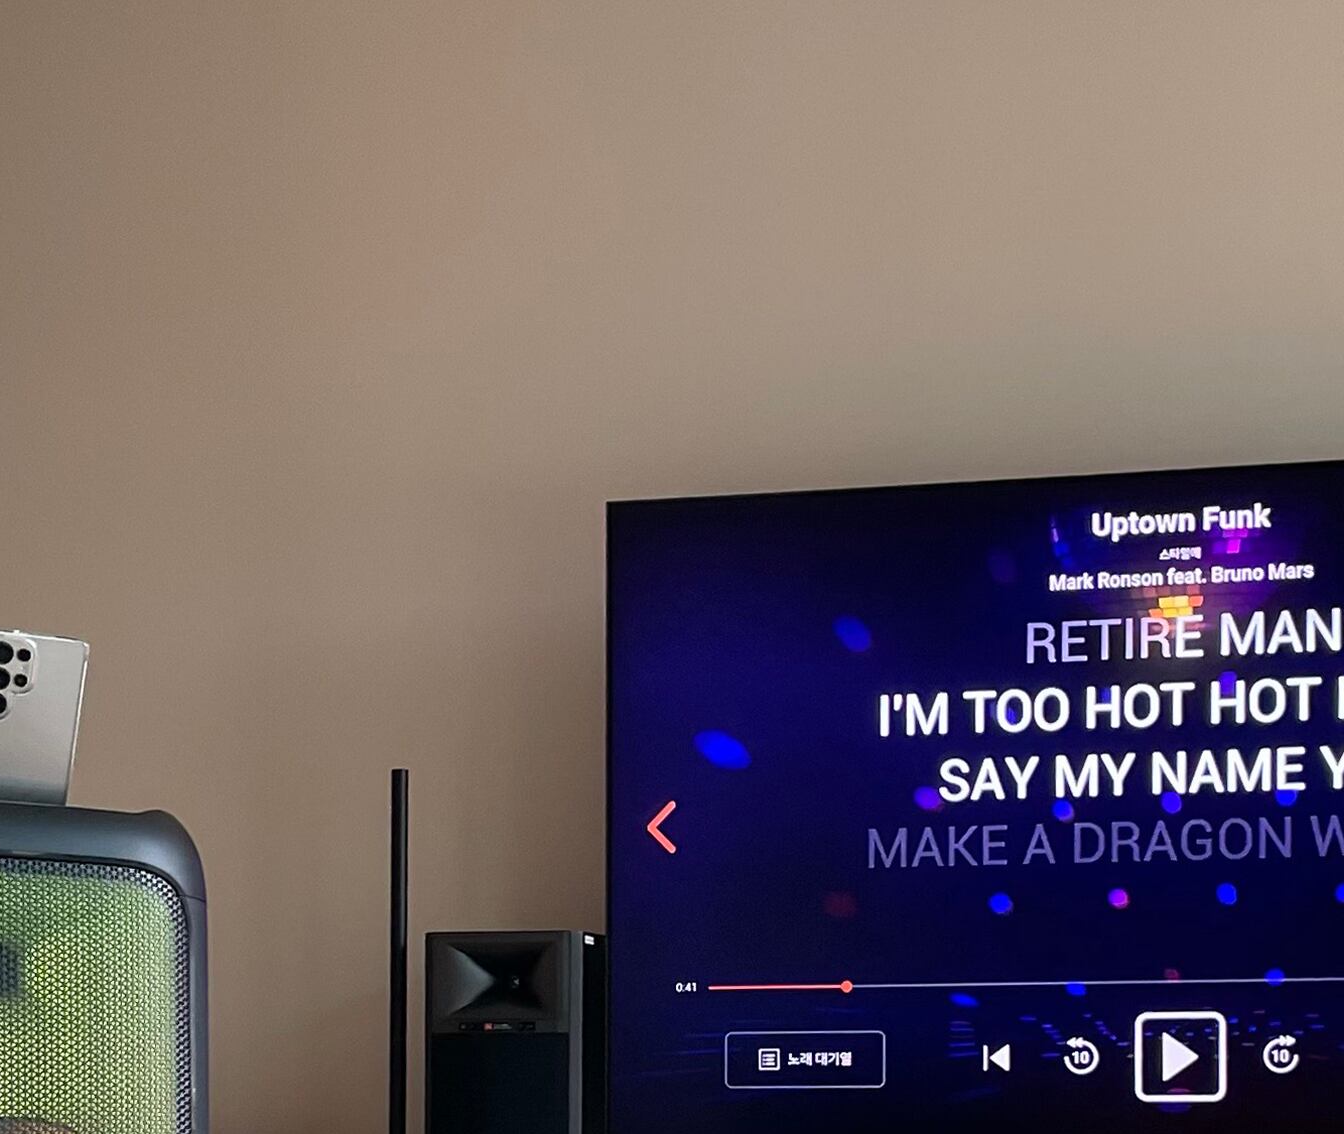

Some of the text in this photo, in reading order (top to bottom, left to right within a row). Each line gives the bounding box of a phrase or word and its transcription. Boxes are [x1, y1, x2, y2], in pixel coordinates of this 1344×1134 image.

[1091, 502, 1272, 542] Uptown Funk
[1048, 562, 1316, 592] Mark Ronson feat. Bruno Mars
[1026, 606, 1343, 664] RETIRE MAN
[878, 690, 950, 738] I'M
[962, 686, 1071, 735] TOO
[1084, 680, 1197, 731] HOT
[1210, 675, 1324, 726] HOT
[937, 754, 1041, 803] SAY
[1054, 752, 1137, 799] MY
[1150, 745, 1307, 796] NAME
[867, 824, 1009, 870] MAKE
[1021, 822, 1057, 866] A
[1073, 815, 1293, 864] DRAGON
[675, 982, 697, 993] 0:41
[787, 1051, 853, 1067] 노래 대기열
[1071, 1050, 1091, 1065] 10
[1271, 1048, 1290, 1063] 10
